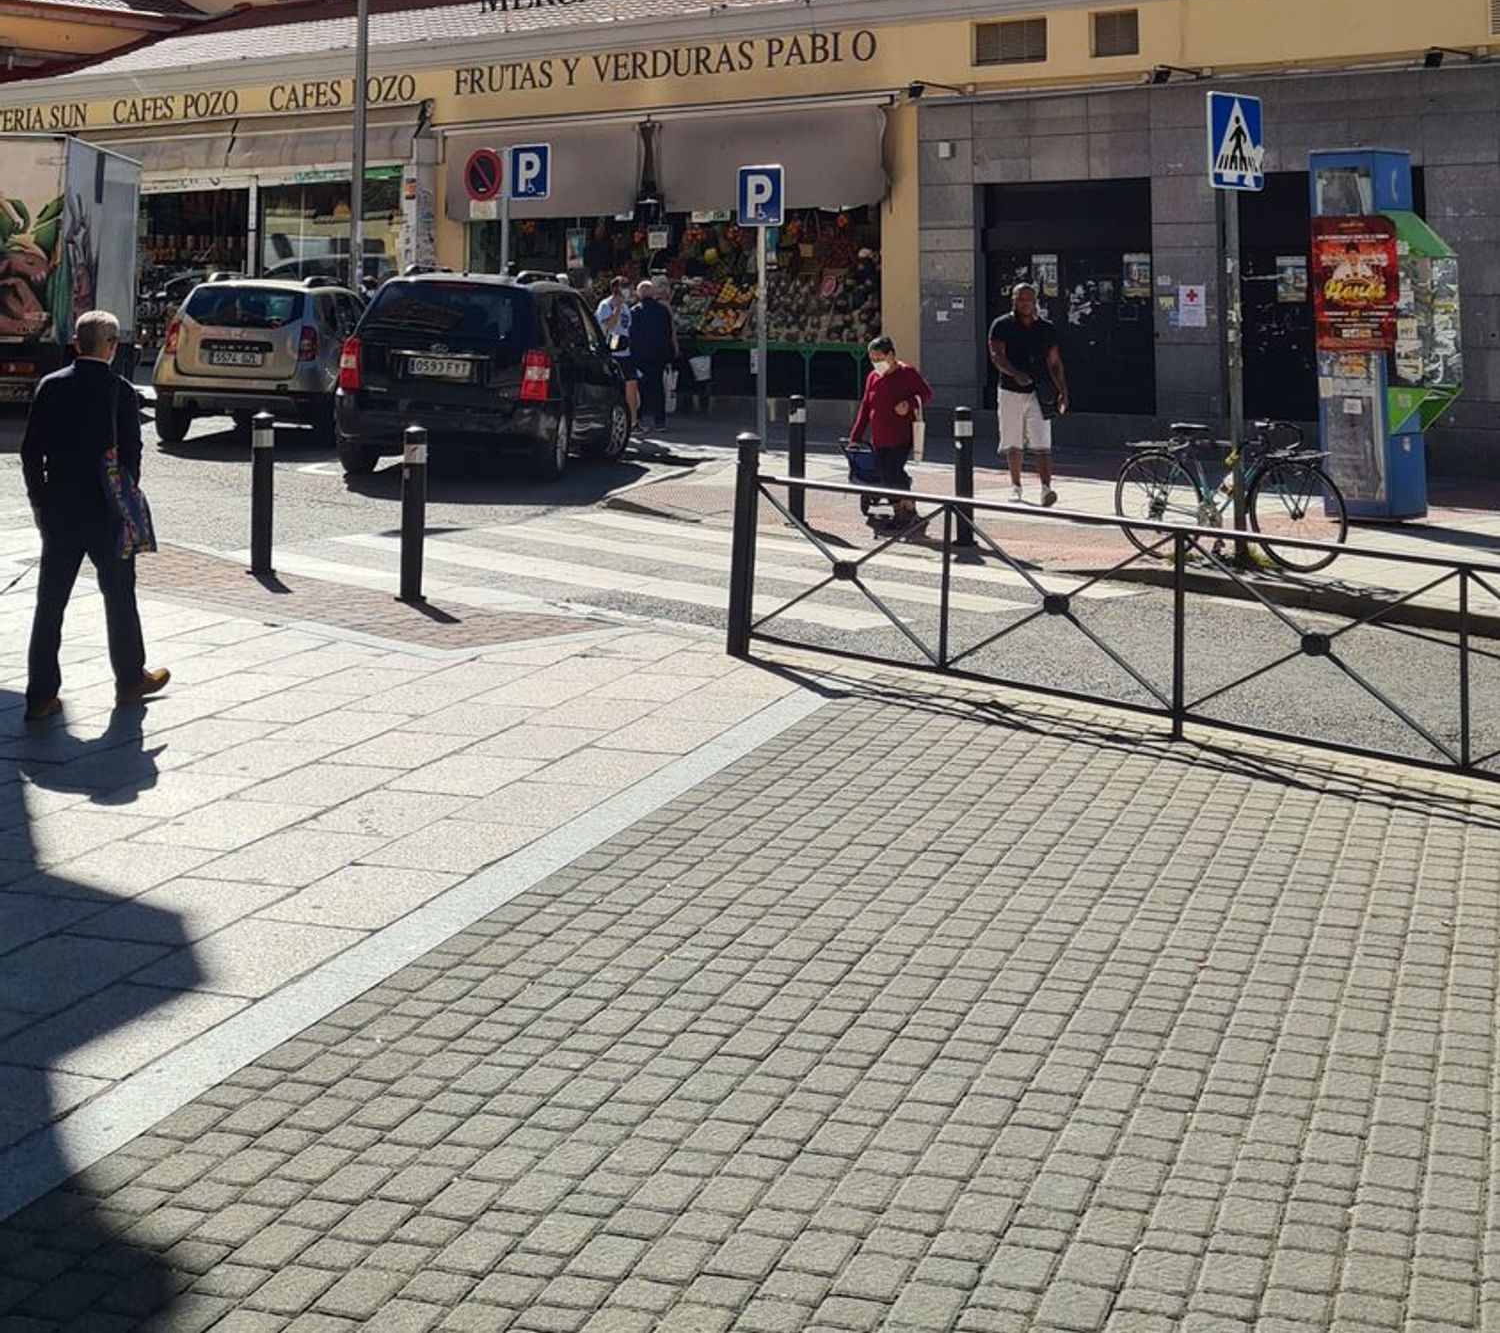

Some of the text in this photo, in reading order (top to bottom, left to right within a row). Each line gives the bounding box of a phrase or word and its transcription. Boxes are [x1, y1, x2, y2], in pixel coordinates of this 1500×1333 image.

[454, 60, 553, 95] FRUTAS
[562, 58, 580, 86] Y
[593, 41, 755, 83] VERDURAS
[113, 90, 239, 124] CAFES POZO
[269, 80, 341, 112] CAFES
[50, 103, 87, 128] SUN
[518, 153, 541, 193] P
[746, 174, 773, 219] P
